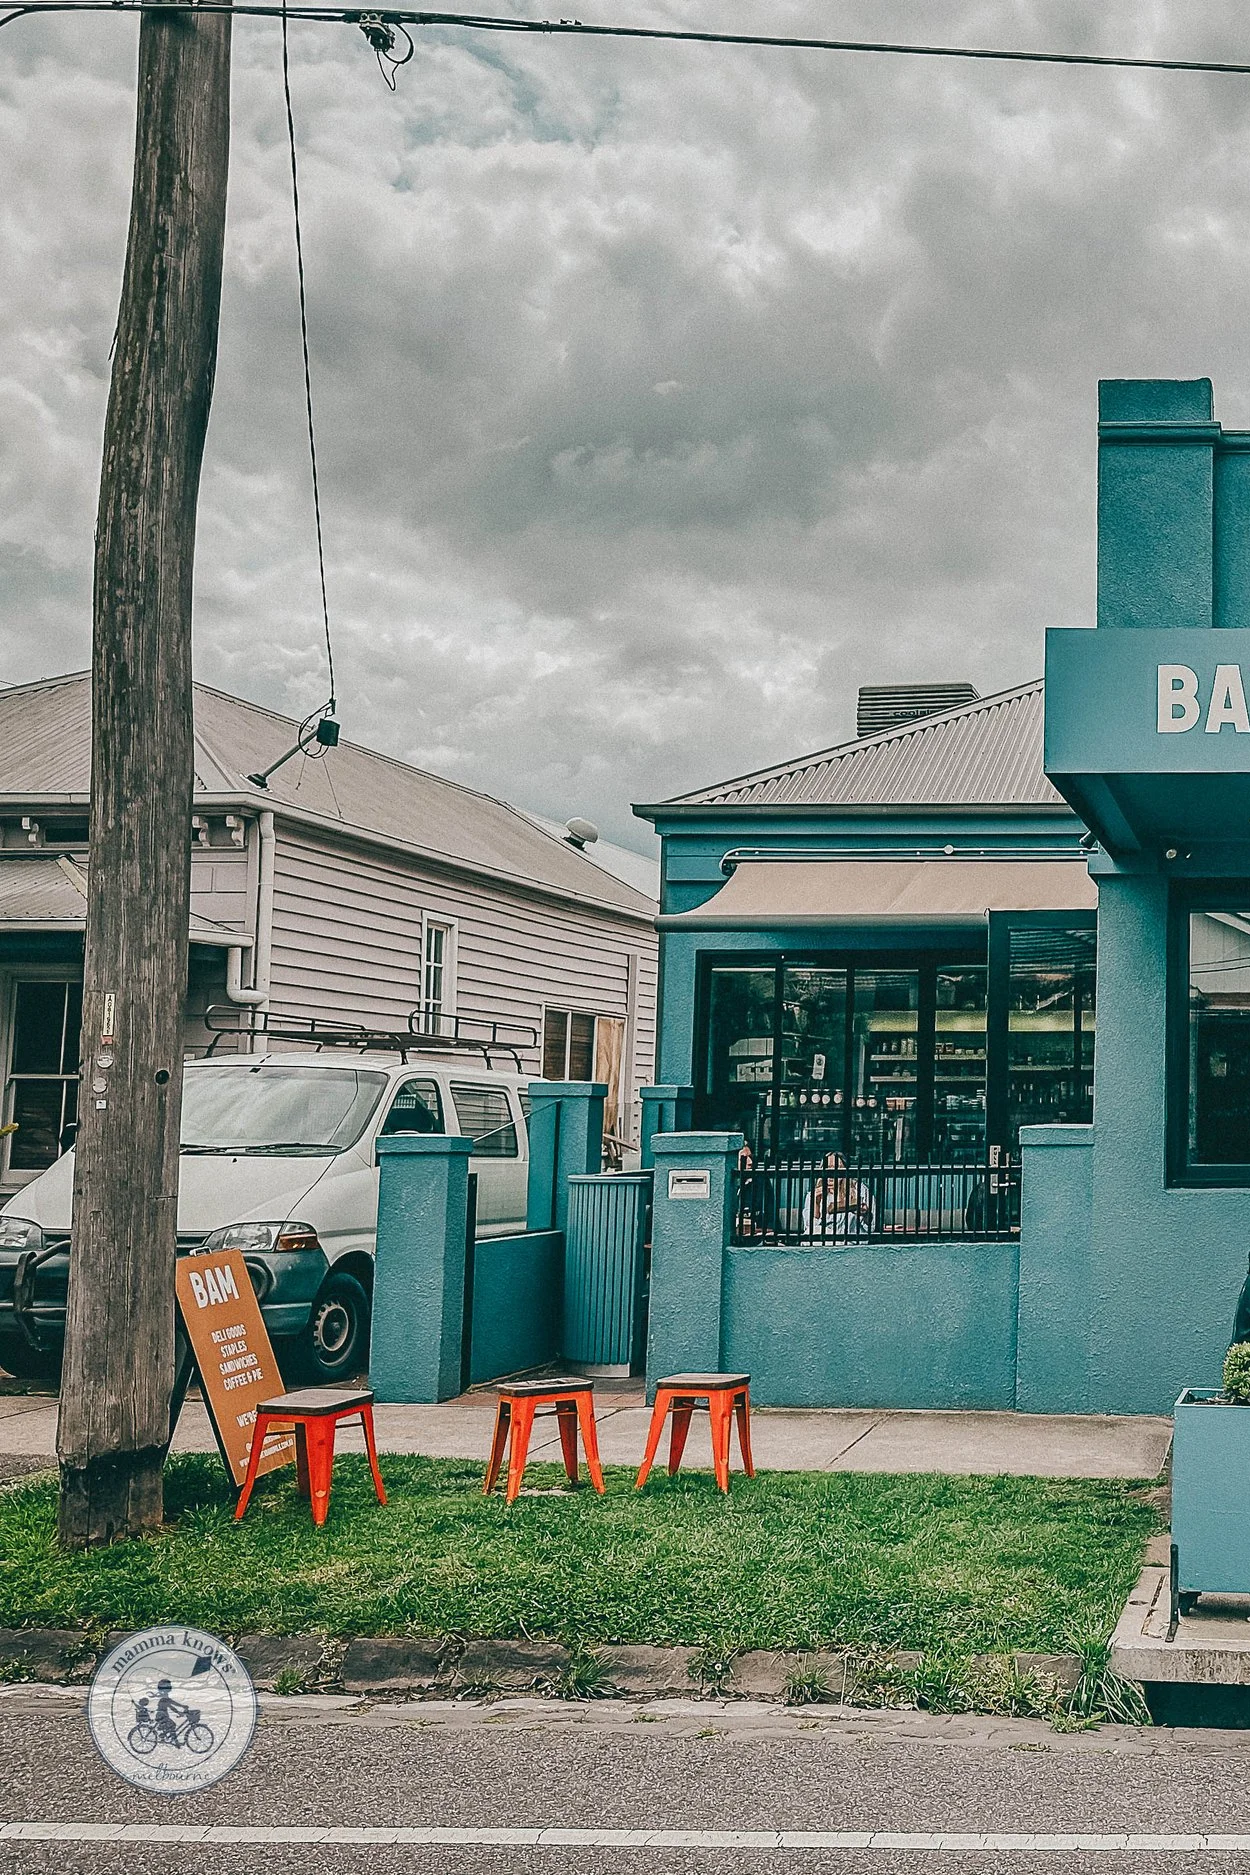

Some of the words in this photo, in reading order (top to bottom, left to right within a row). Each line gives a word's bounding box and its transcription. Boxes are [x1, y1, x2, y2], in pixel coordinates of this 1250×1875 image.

[188, 1264, 240, 1308] BAM
[211, 1329, 227, 1343] DELI
[226, 1324, 247, 1339] GOODS
[220, 1340, 247, 1358] STAPLES
[219, 1353, 258, 1375] SANDWICHES
[223, 1373, 248, 1391] COFFEE
[252, 1368, 264, 1382] PIE
